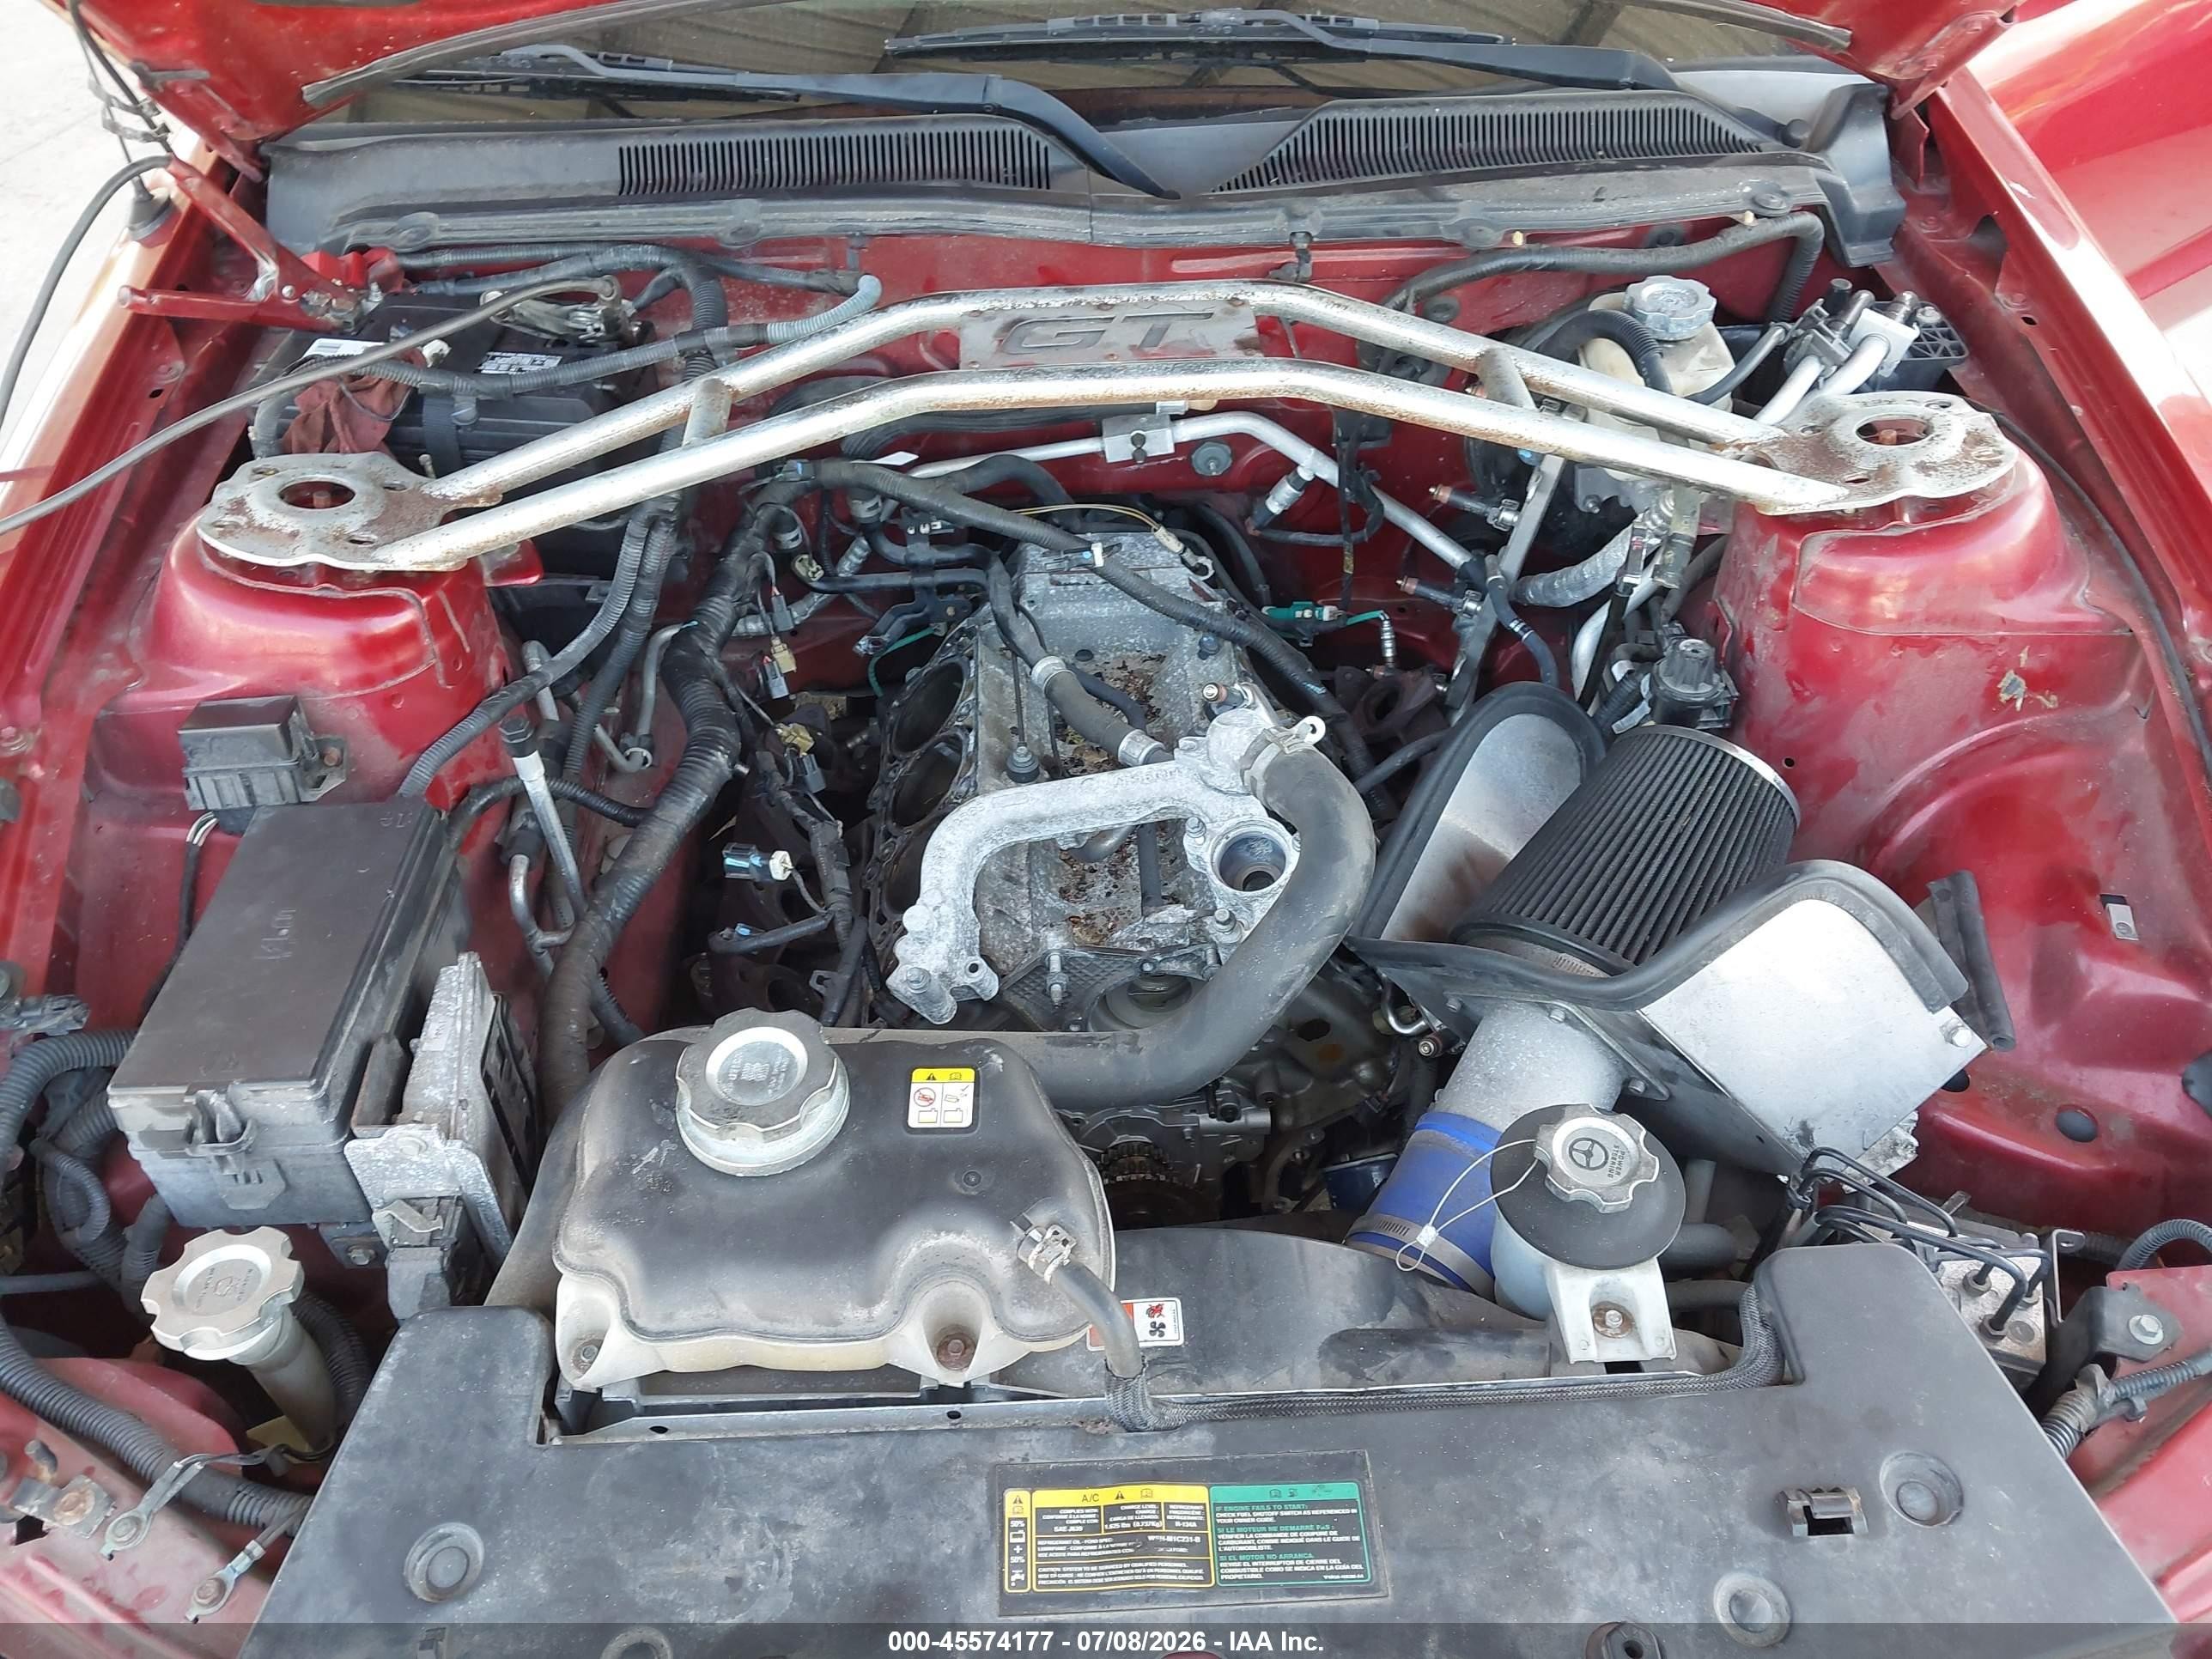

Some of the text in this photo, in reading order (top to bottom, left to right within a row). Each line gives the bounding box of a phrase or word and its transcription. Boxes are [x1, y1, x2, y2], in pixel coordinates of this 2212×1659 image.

[1000, 312, 1214, 355] GT
[1607, 1144, 1620, 1179] STEERING
[1614, 1150, 1626, 1176] POWER
[1081, 1493, 1099, 1502] A/C
